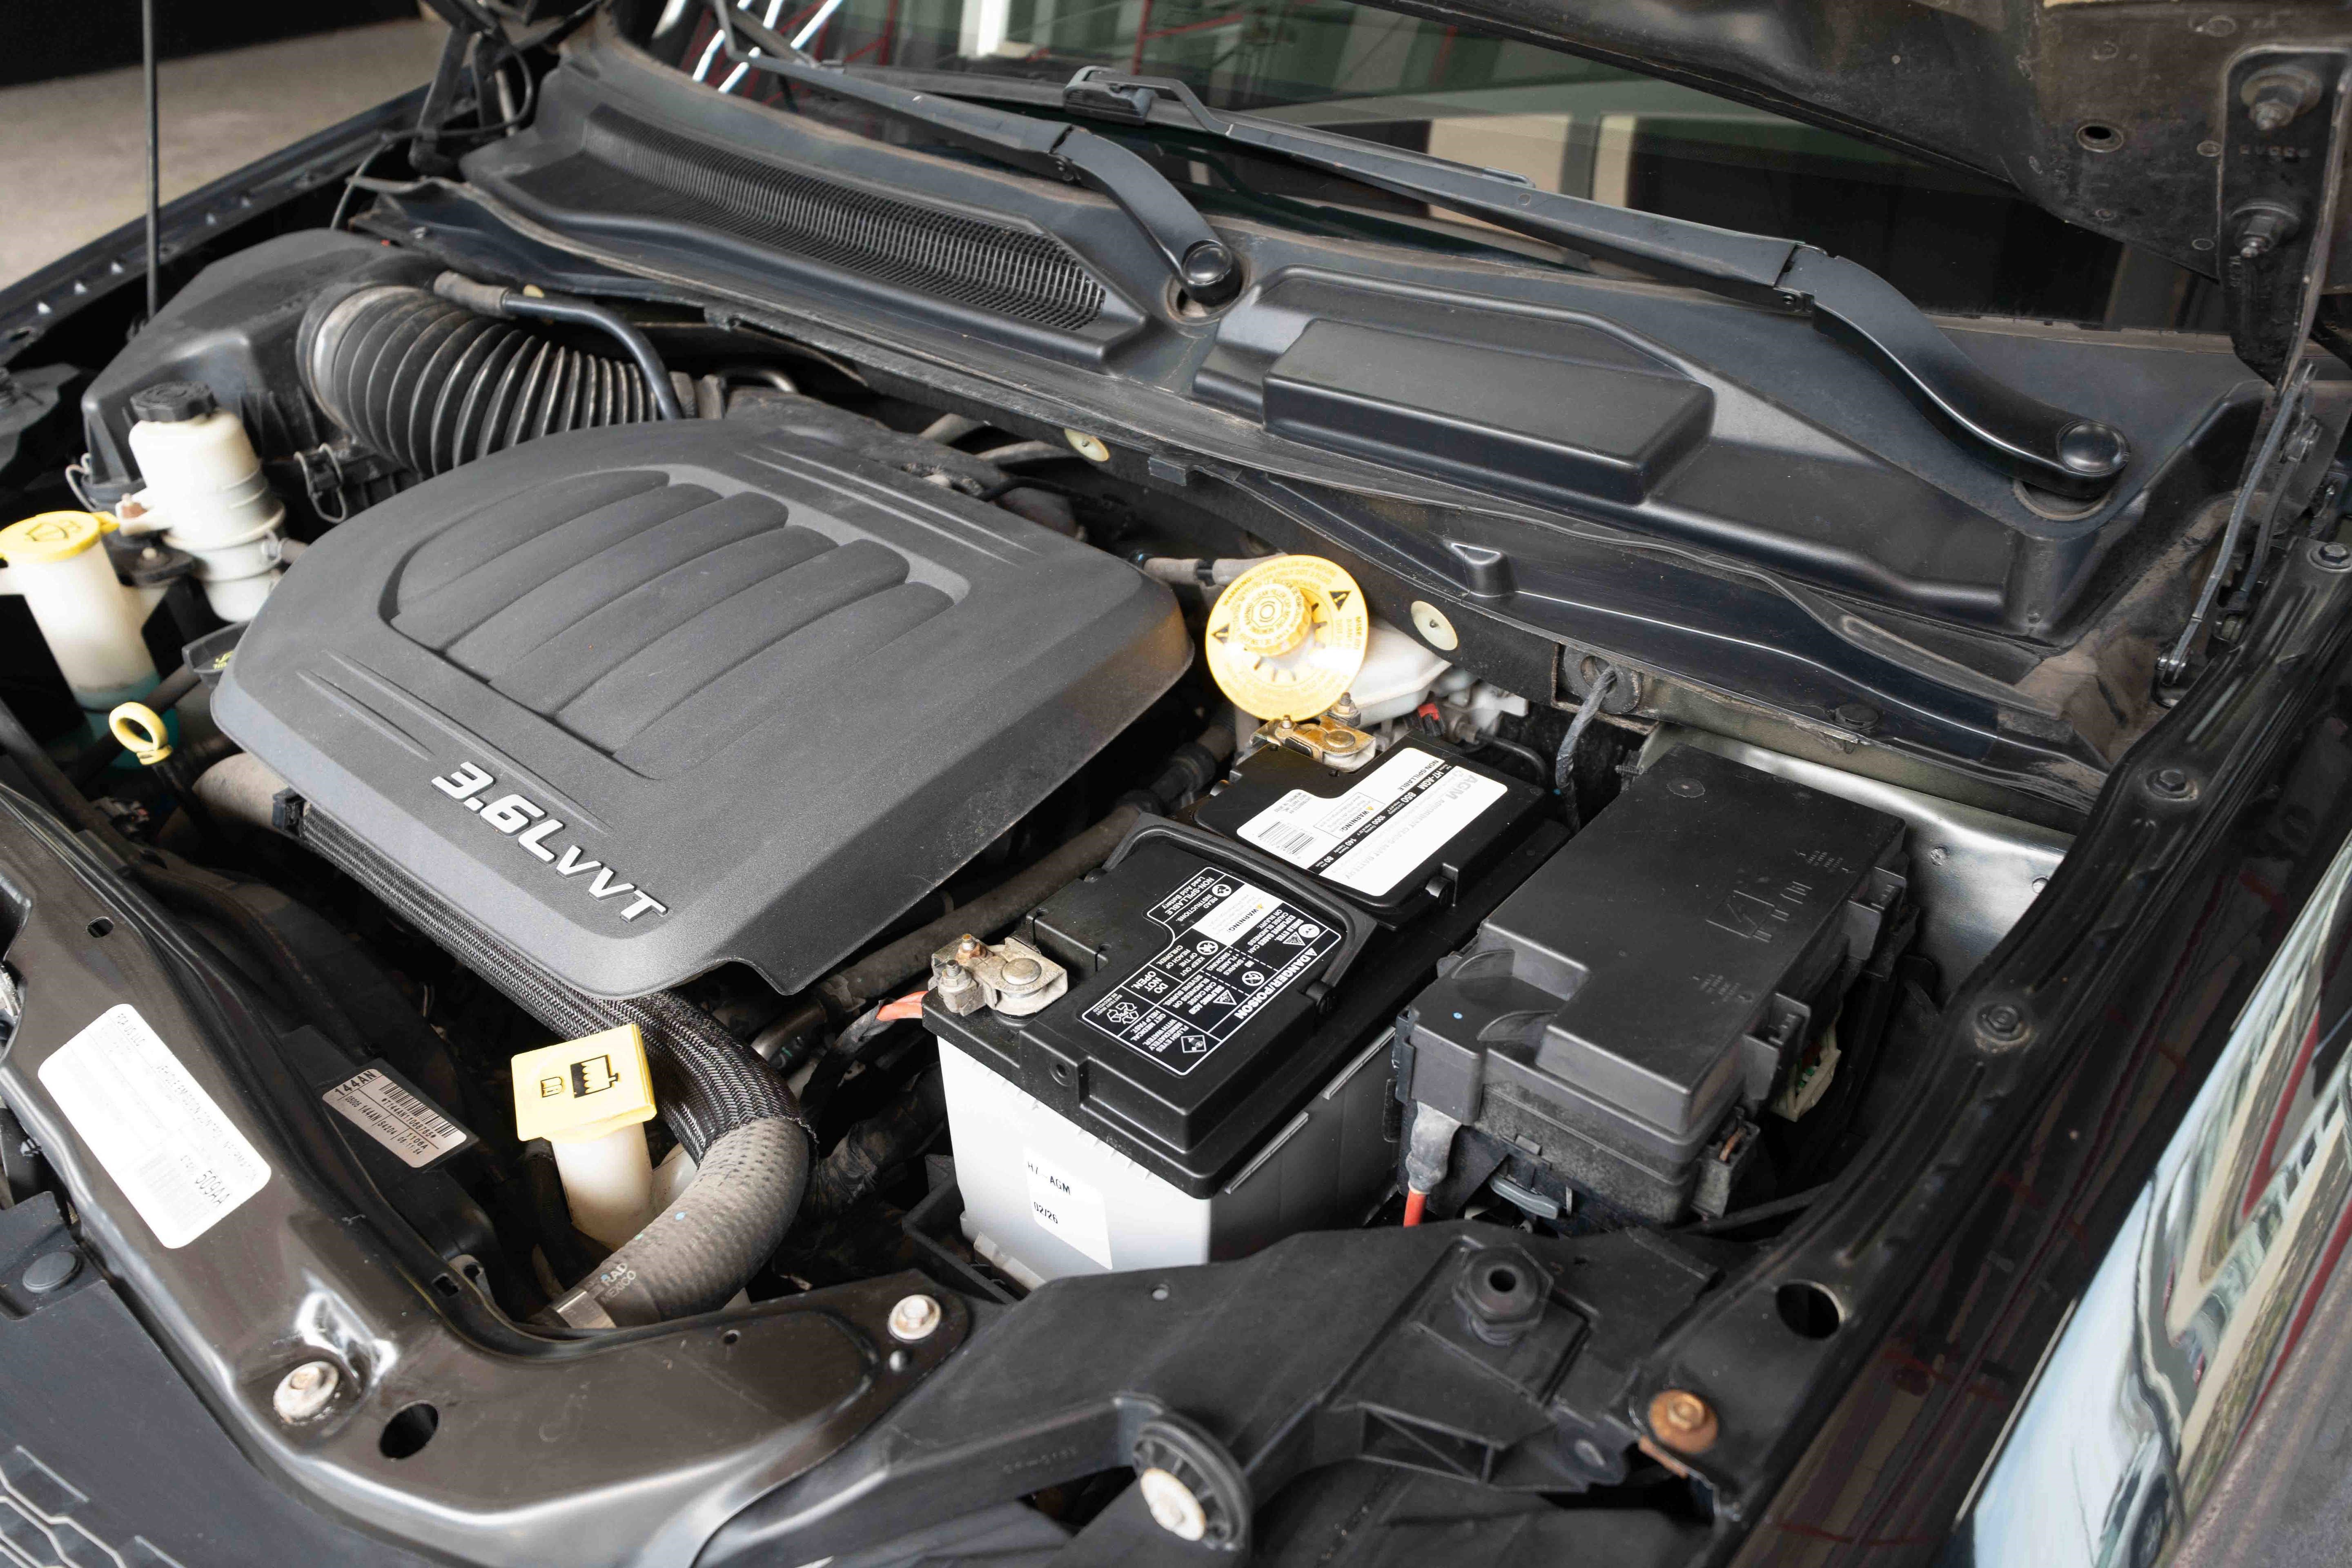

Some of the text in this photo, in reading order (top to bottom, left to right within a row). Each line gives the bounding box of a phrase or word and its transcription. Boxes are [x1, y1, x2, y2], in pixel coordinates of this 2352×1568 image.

[1396, 760, 1440, 791] NON-SPILLABLE
[1416, 770, 1444, 789] H7-AGM
[1444, 775, 1480, 800] AGM
[1399, 791, 1417, 803] 850
[1338, 810, 1370, 832] WARNING:
[1370, 814, 1387, 825] 1000
[1343, 837, 1357, 846] 140
[1160, 876, 1205, 909] Lead Acid Battery
[1165, 876, 1214, 915] NON-SPILLABLE
[1175, 893, 1213, 922] INSTRUCTIONS.
[1203, 897, 1218, 909] READ
[1226, 908, 1259, 933] WARNING:
[1256, 915, 1275, 929] INJURY.
[1270, 911, 1289, 926] CAUSE
[1246, 924, 1274, 946] BLINDNESS
[1156, 944, 1183, 966] CHILDREN.
[1171, 948, 1190, 963] REACH
[1247, 944, 1261, 954] CAN
[1178, 957, 1192, 967] THE
[1179, 956, 1205, 976] KEEP OUT
[1130, 970, 1157, 990] OPEN.
[1143, 977, 1163, 991] NOT
[1153, 982, 1168, 994] DO
[1181, 974, 1203, 991] SEVERE
[1233, 953, 1311, 1019] DANGER/POISON
[1172, 978, 1209, 1008] BLINDNESS OR
[1187, 981, 1217, 1005] CAN CAUSE
[1143, 1009, 1160, 1022] HELP
[1152, 1013, 1166, 1023] GET
[333, 1070, 377, 1096] 144AN
[357, 1104, 383, 1122] 144AN
[376, 1120, 398, 1136] S4204
[405, 1132, 429, 1149] 1106A
[192, 1167, 234, 1209] 509AA
